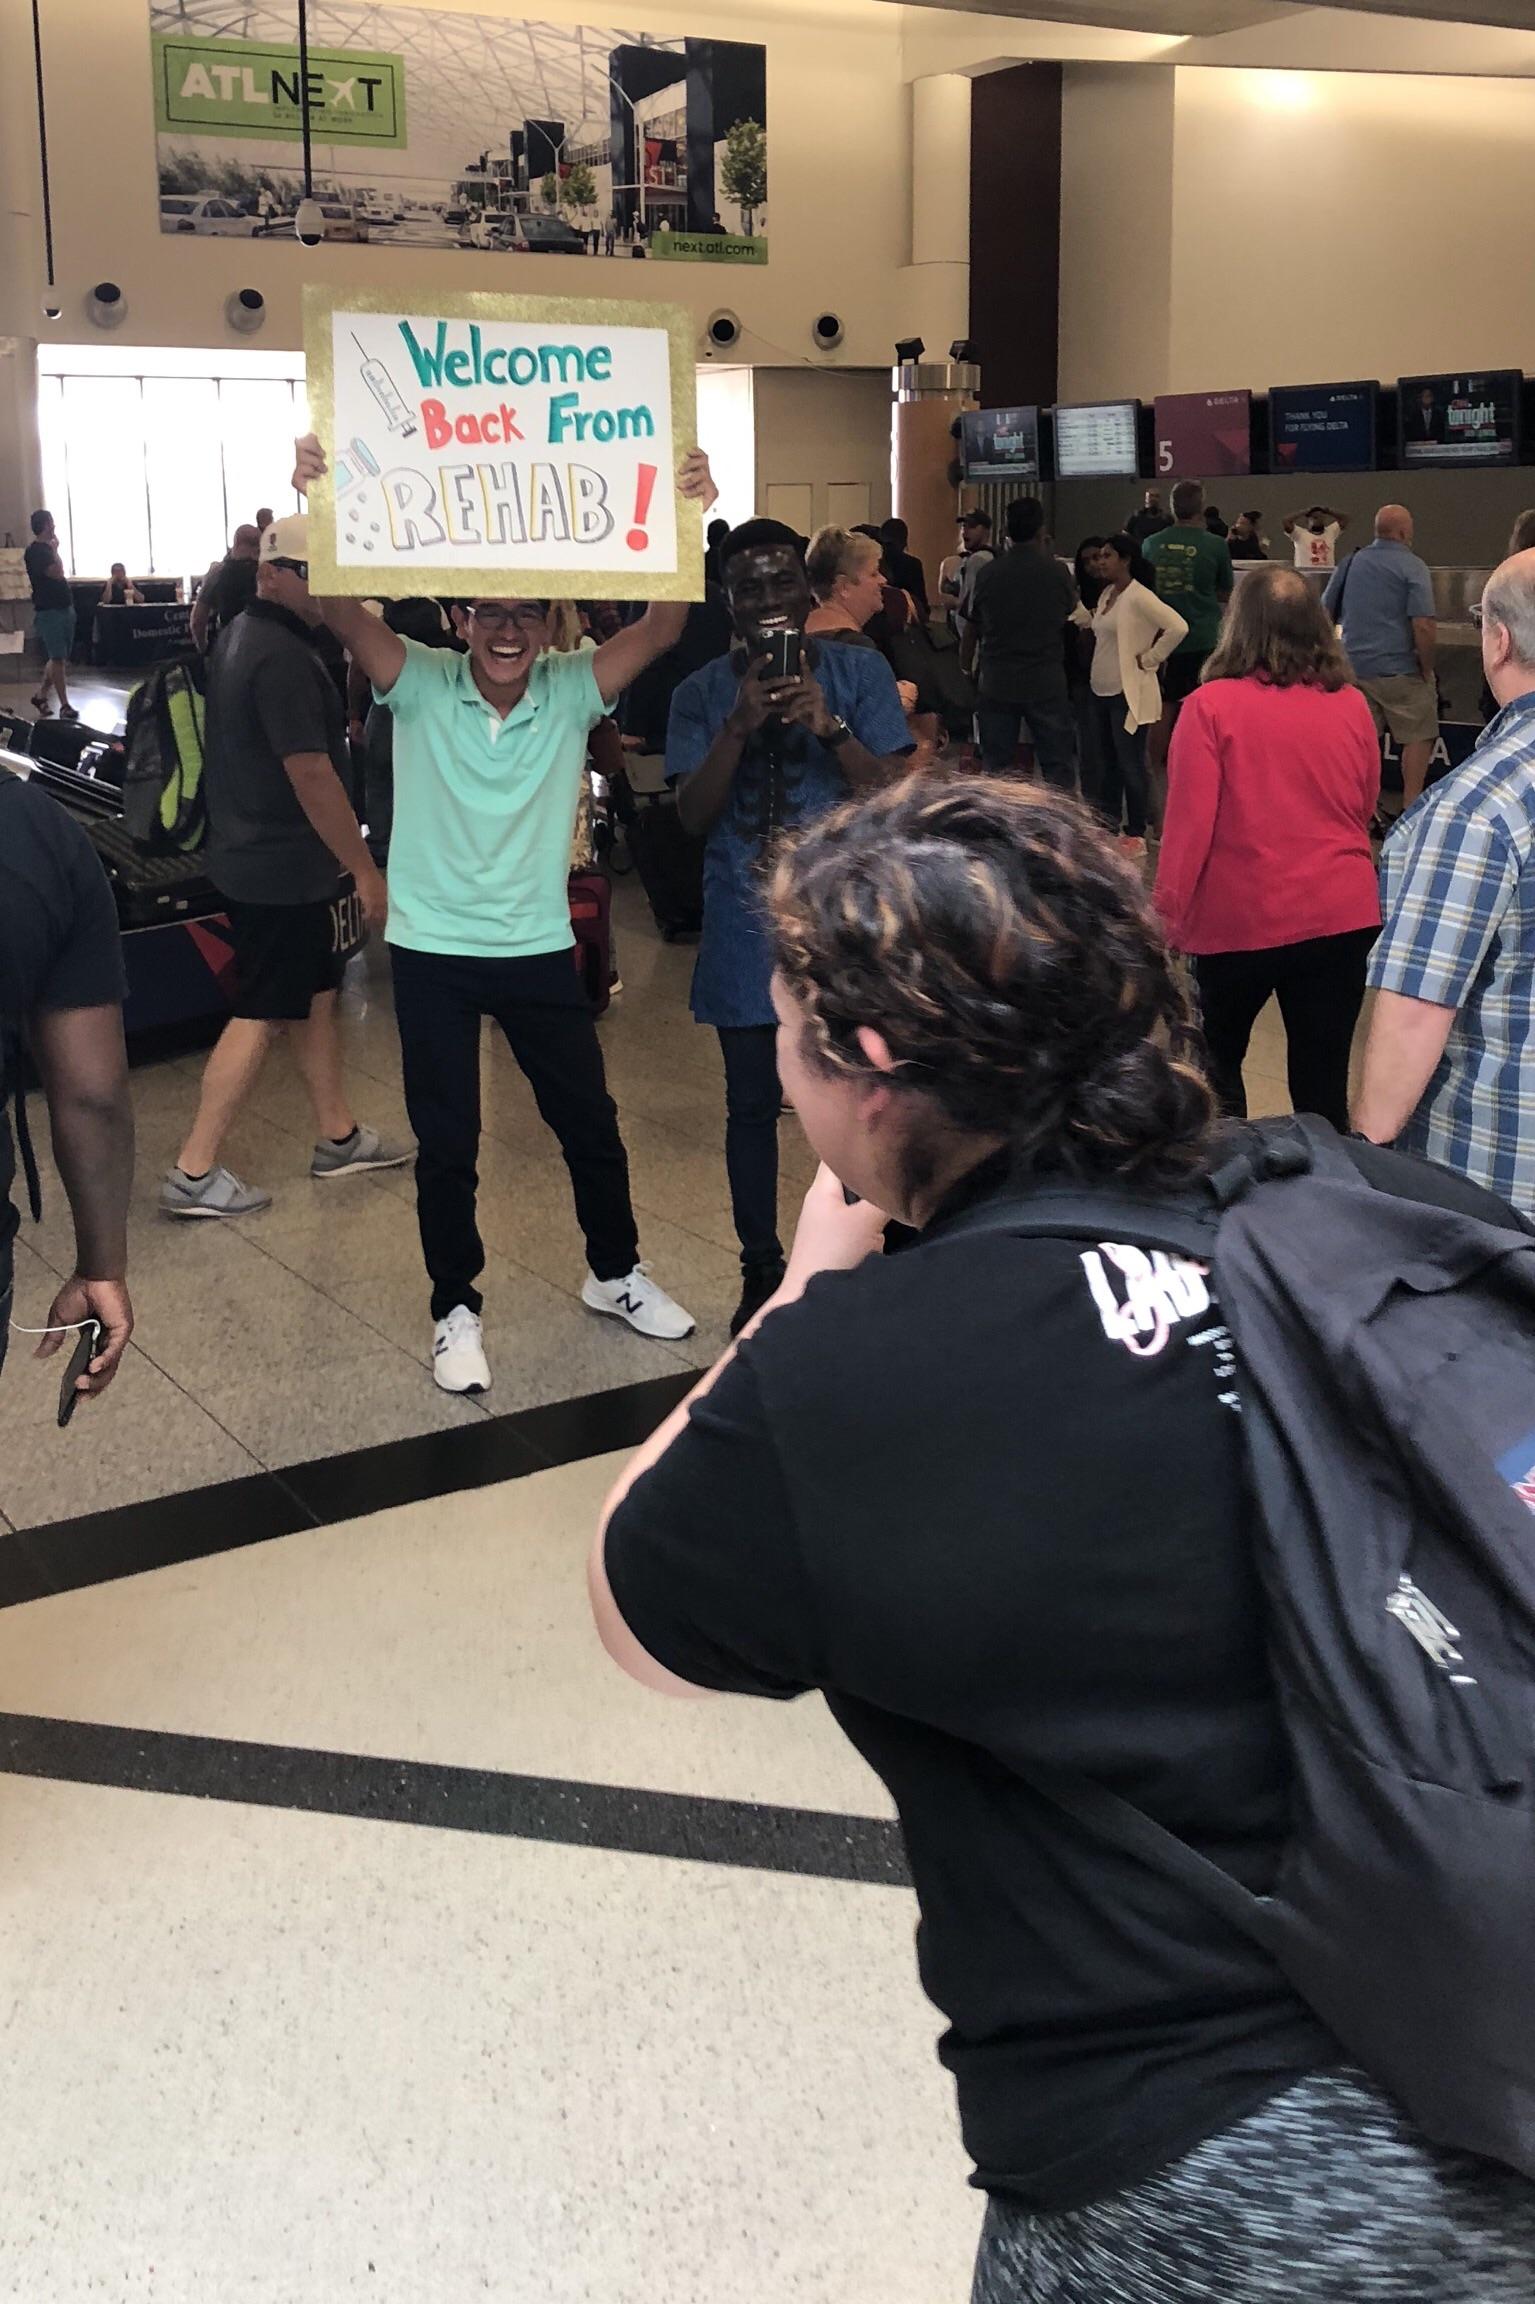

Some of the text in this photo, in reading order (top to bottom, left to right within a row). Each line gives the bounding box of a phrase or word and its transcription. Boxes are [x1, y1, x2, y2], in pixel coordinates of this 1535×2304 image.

[398, 319, 613, 388] Welcome
[420, 391, 656, 450] Back From
[1159, 441, 1174, 472] 5
[616, 1292, 644, 1314] N
